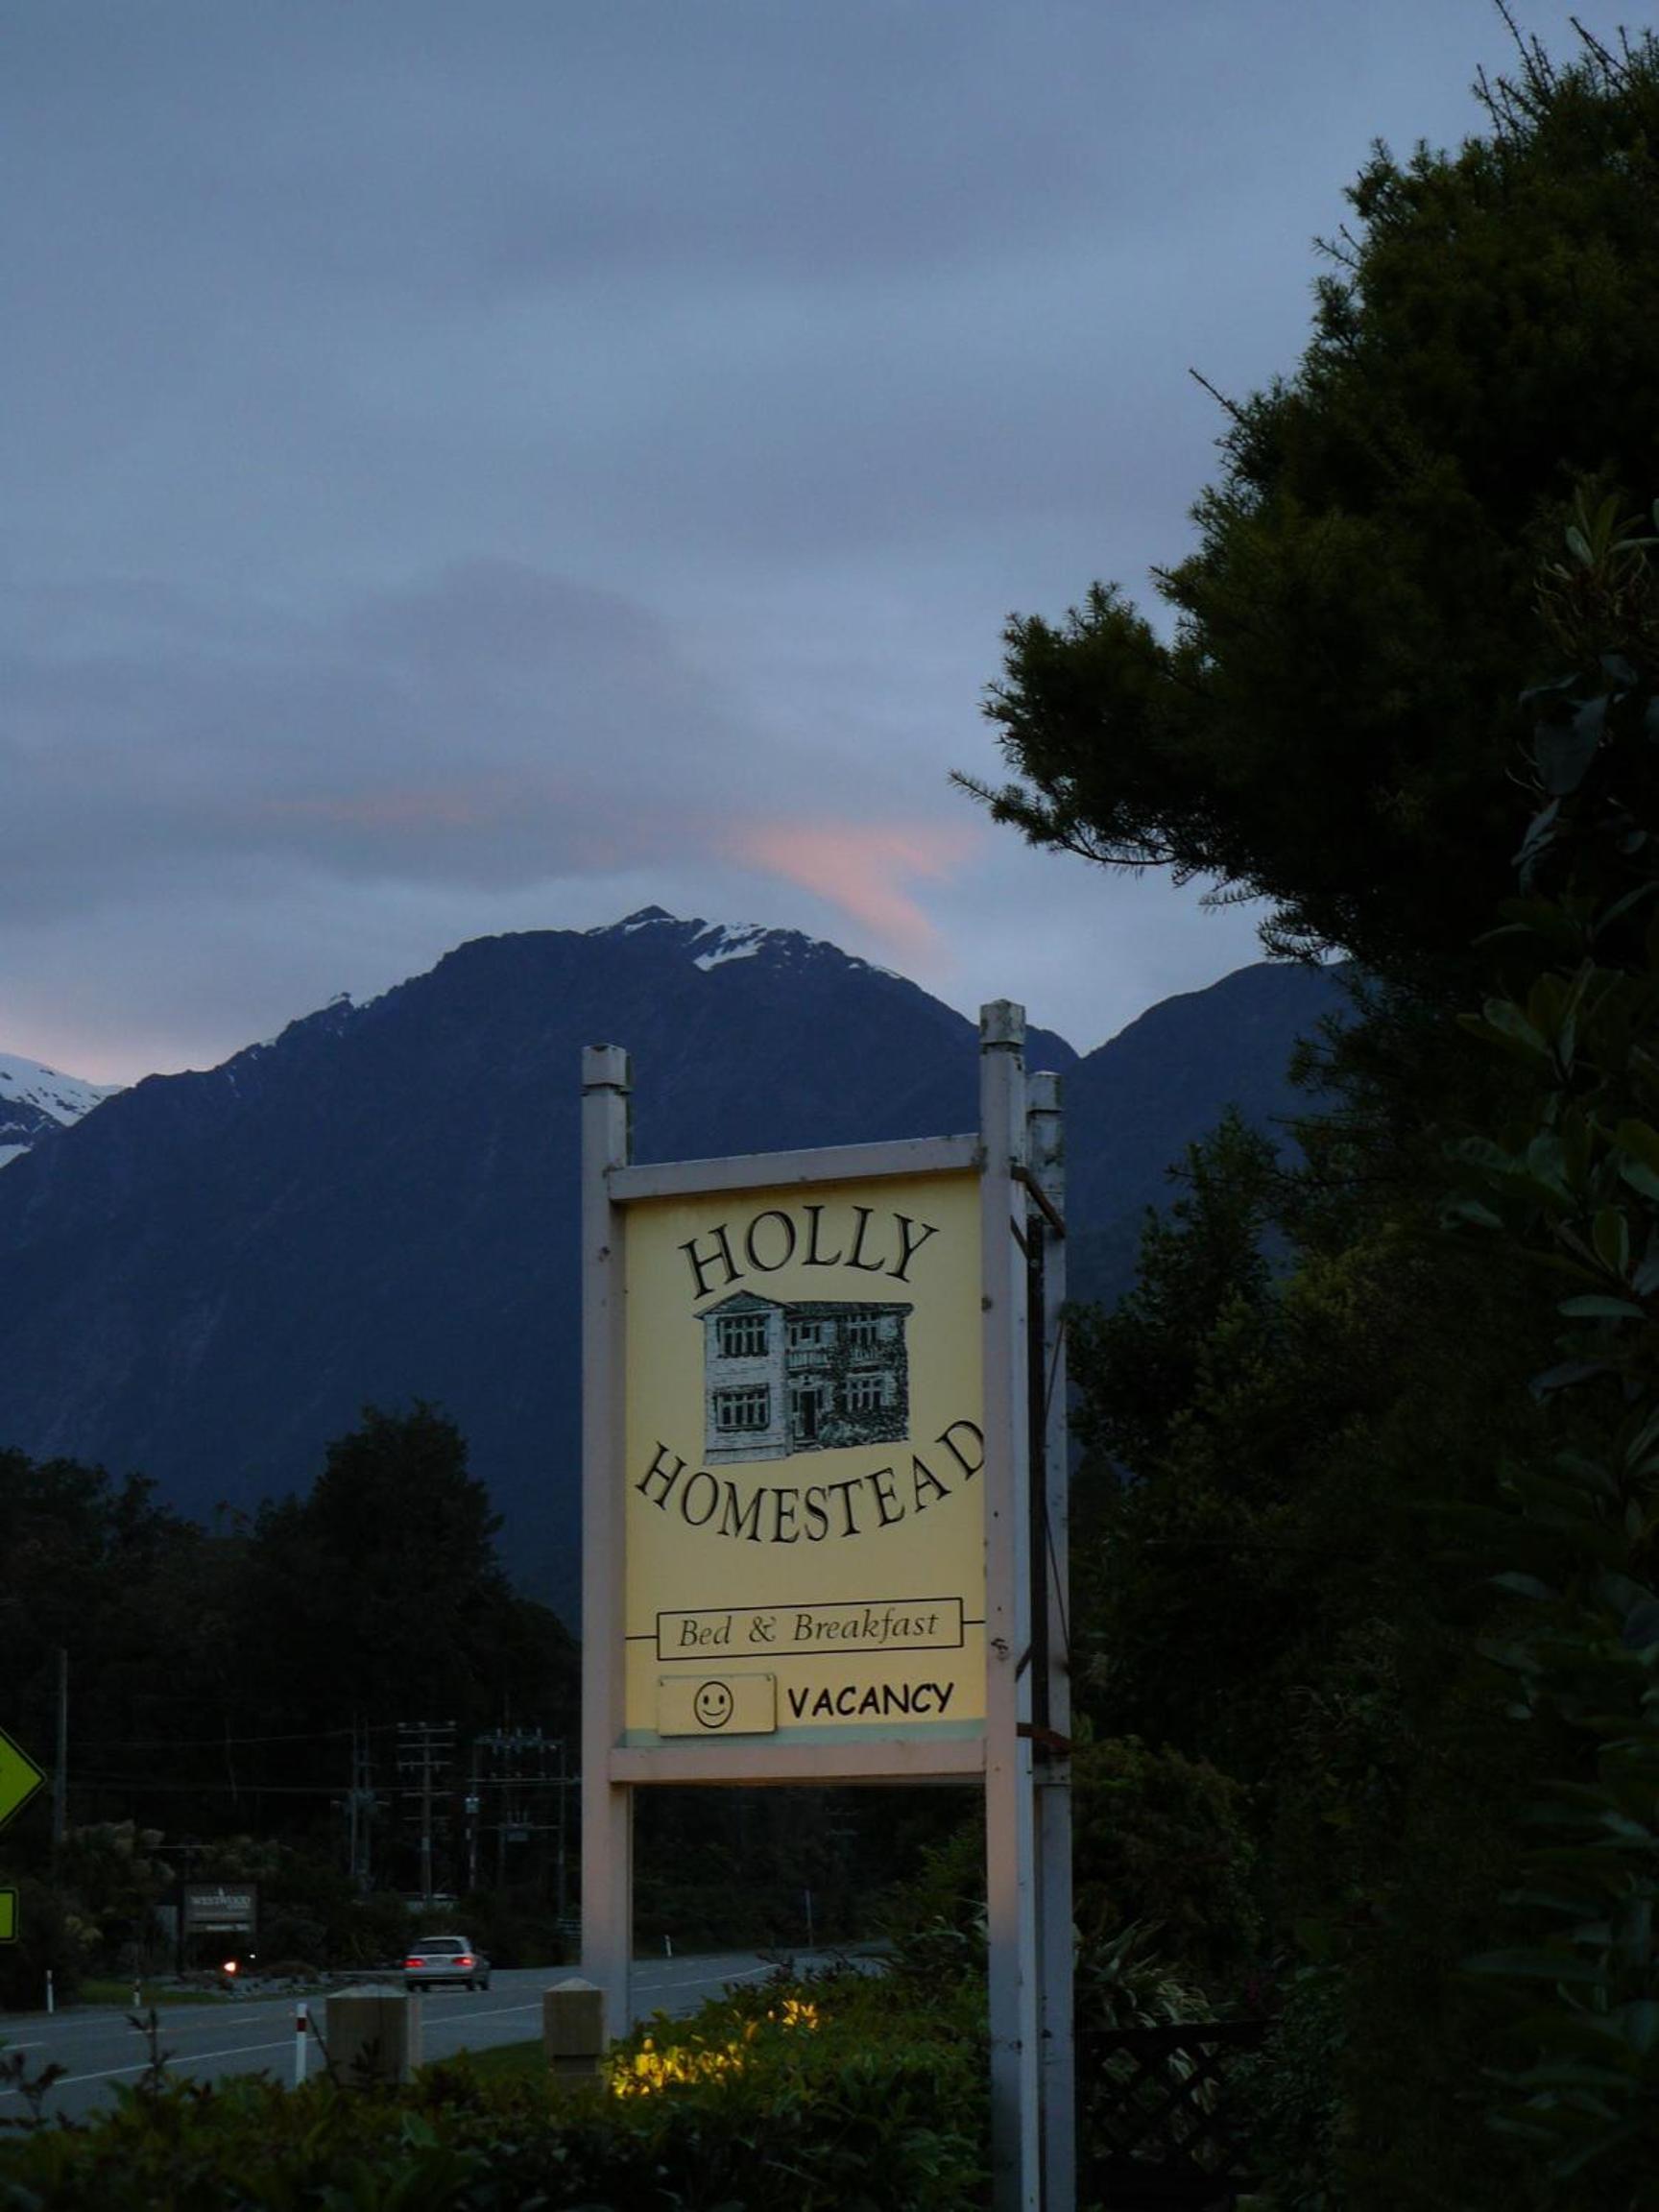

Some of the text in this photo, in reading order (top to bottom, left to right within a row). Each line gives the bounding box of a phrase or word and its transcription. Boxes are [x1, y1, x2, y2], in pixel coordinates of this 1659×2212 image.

[678, 1205, 939, 1300] HOLLY
[635, 1420, 984, 1543] HOMESTEAD
[680, 1608, 939, 1647] Bed & Breakfast
[788, 1682, 953, 1718] VACANCY
